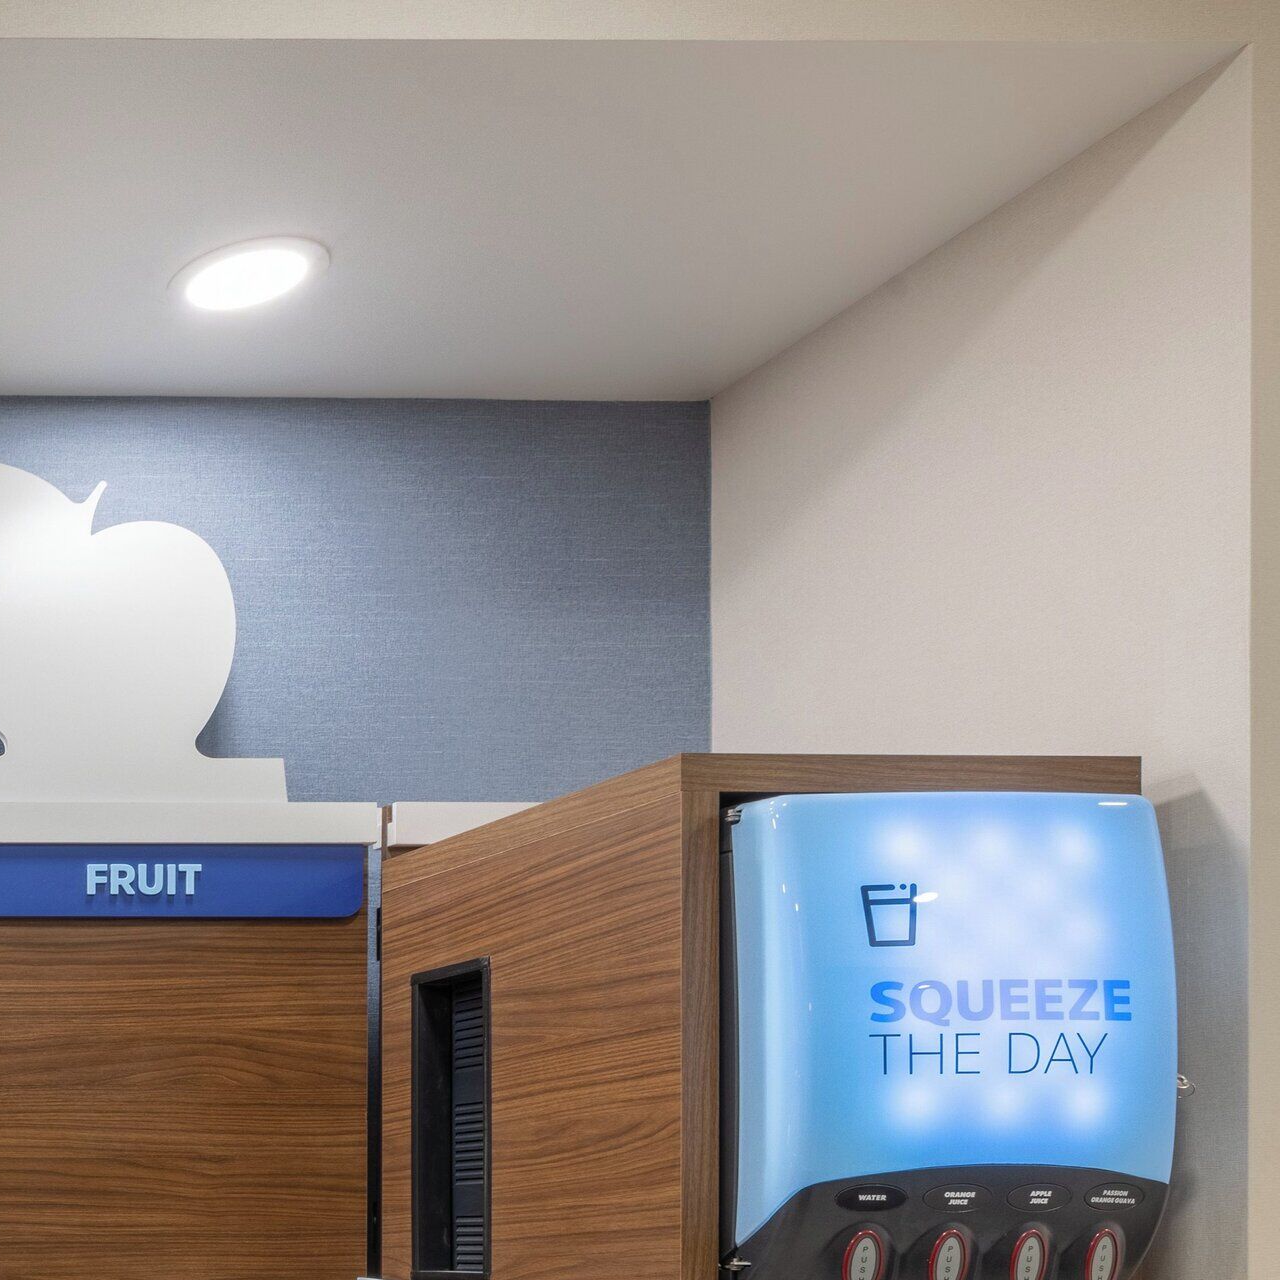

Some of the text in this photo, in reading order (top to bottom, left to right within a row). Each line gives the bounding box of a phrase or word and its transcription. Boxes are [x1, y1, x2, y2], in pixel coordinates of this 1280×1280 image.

[85, 863, 203, 896] FRUIT
[869, 978, 1133, 1027] SQUEEZE
[868, 1032, 1109, 1076] THE DAY
